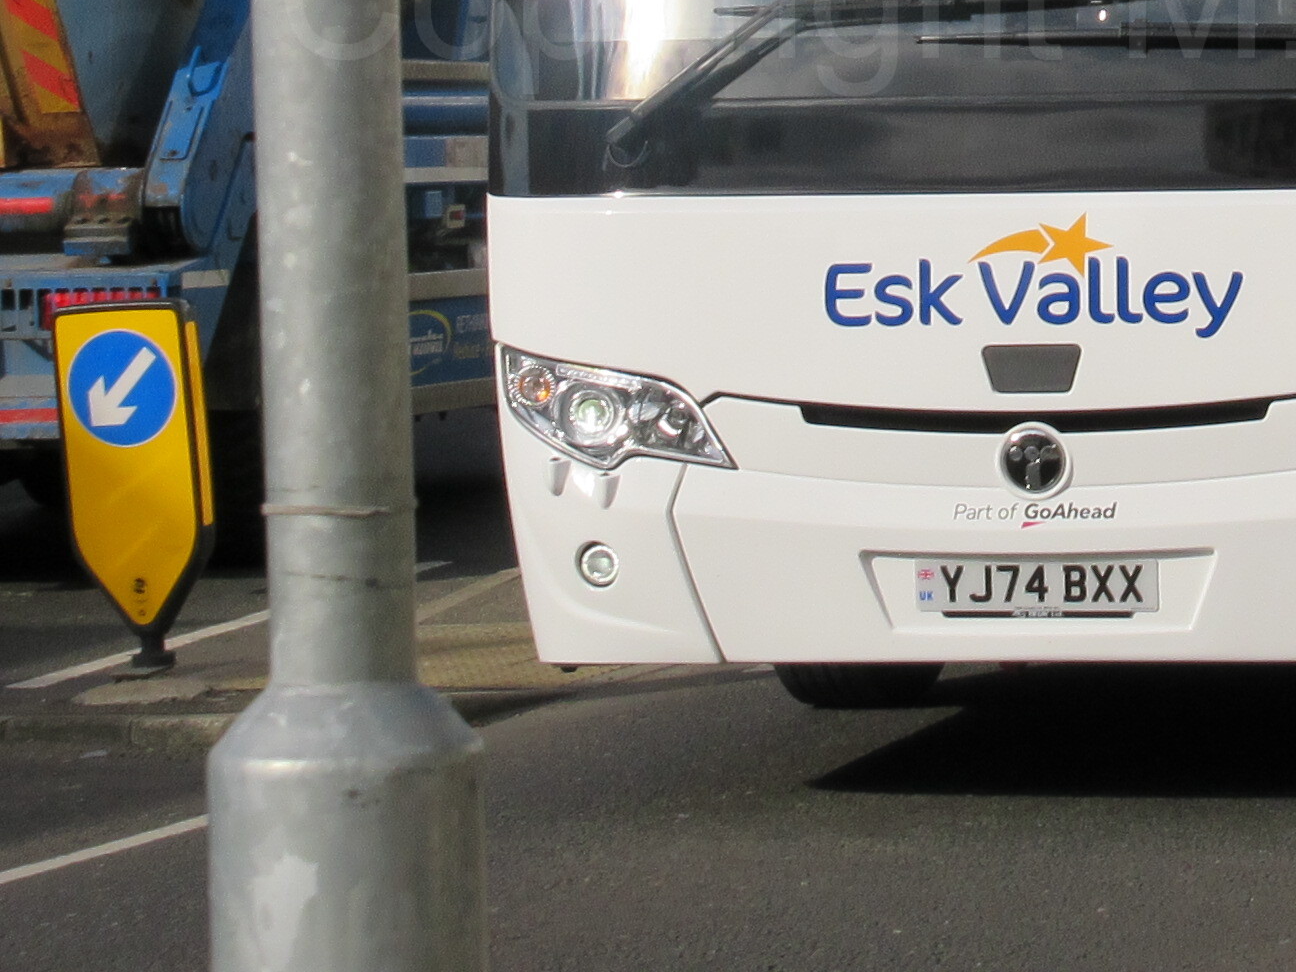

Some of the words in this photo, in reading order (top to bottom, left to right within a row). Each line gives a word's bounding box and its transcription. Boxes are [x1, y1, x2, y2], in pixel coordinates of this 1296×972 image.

[824, 258, 963, 327] Esk
[978, 255, 1243, 339] Valley
[953, 503, 993, 521] Part
[997, 502, 1020, 521] of
[1024, 501, 1118, 520] GoAhead
[919, 590, 934, 601] UK
[940, 564, 1050, 603] YJ74
[1063, 564, 1144, 603] BXX
